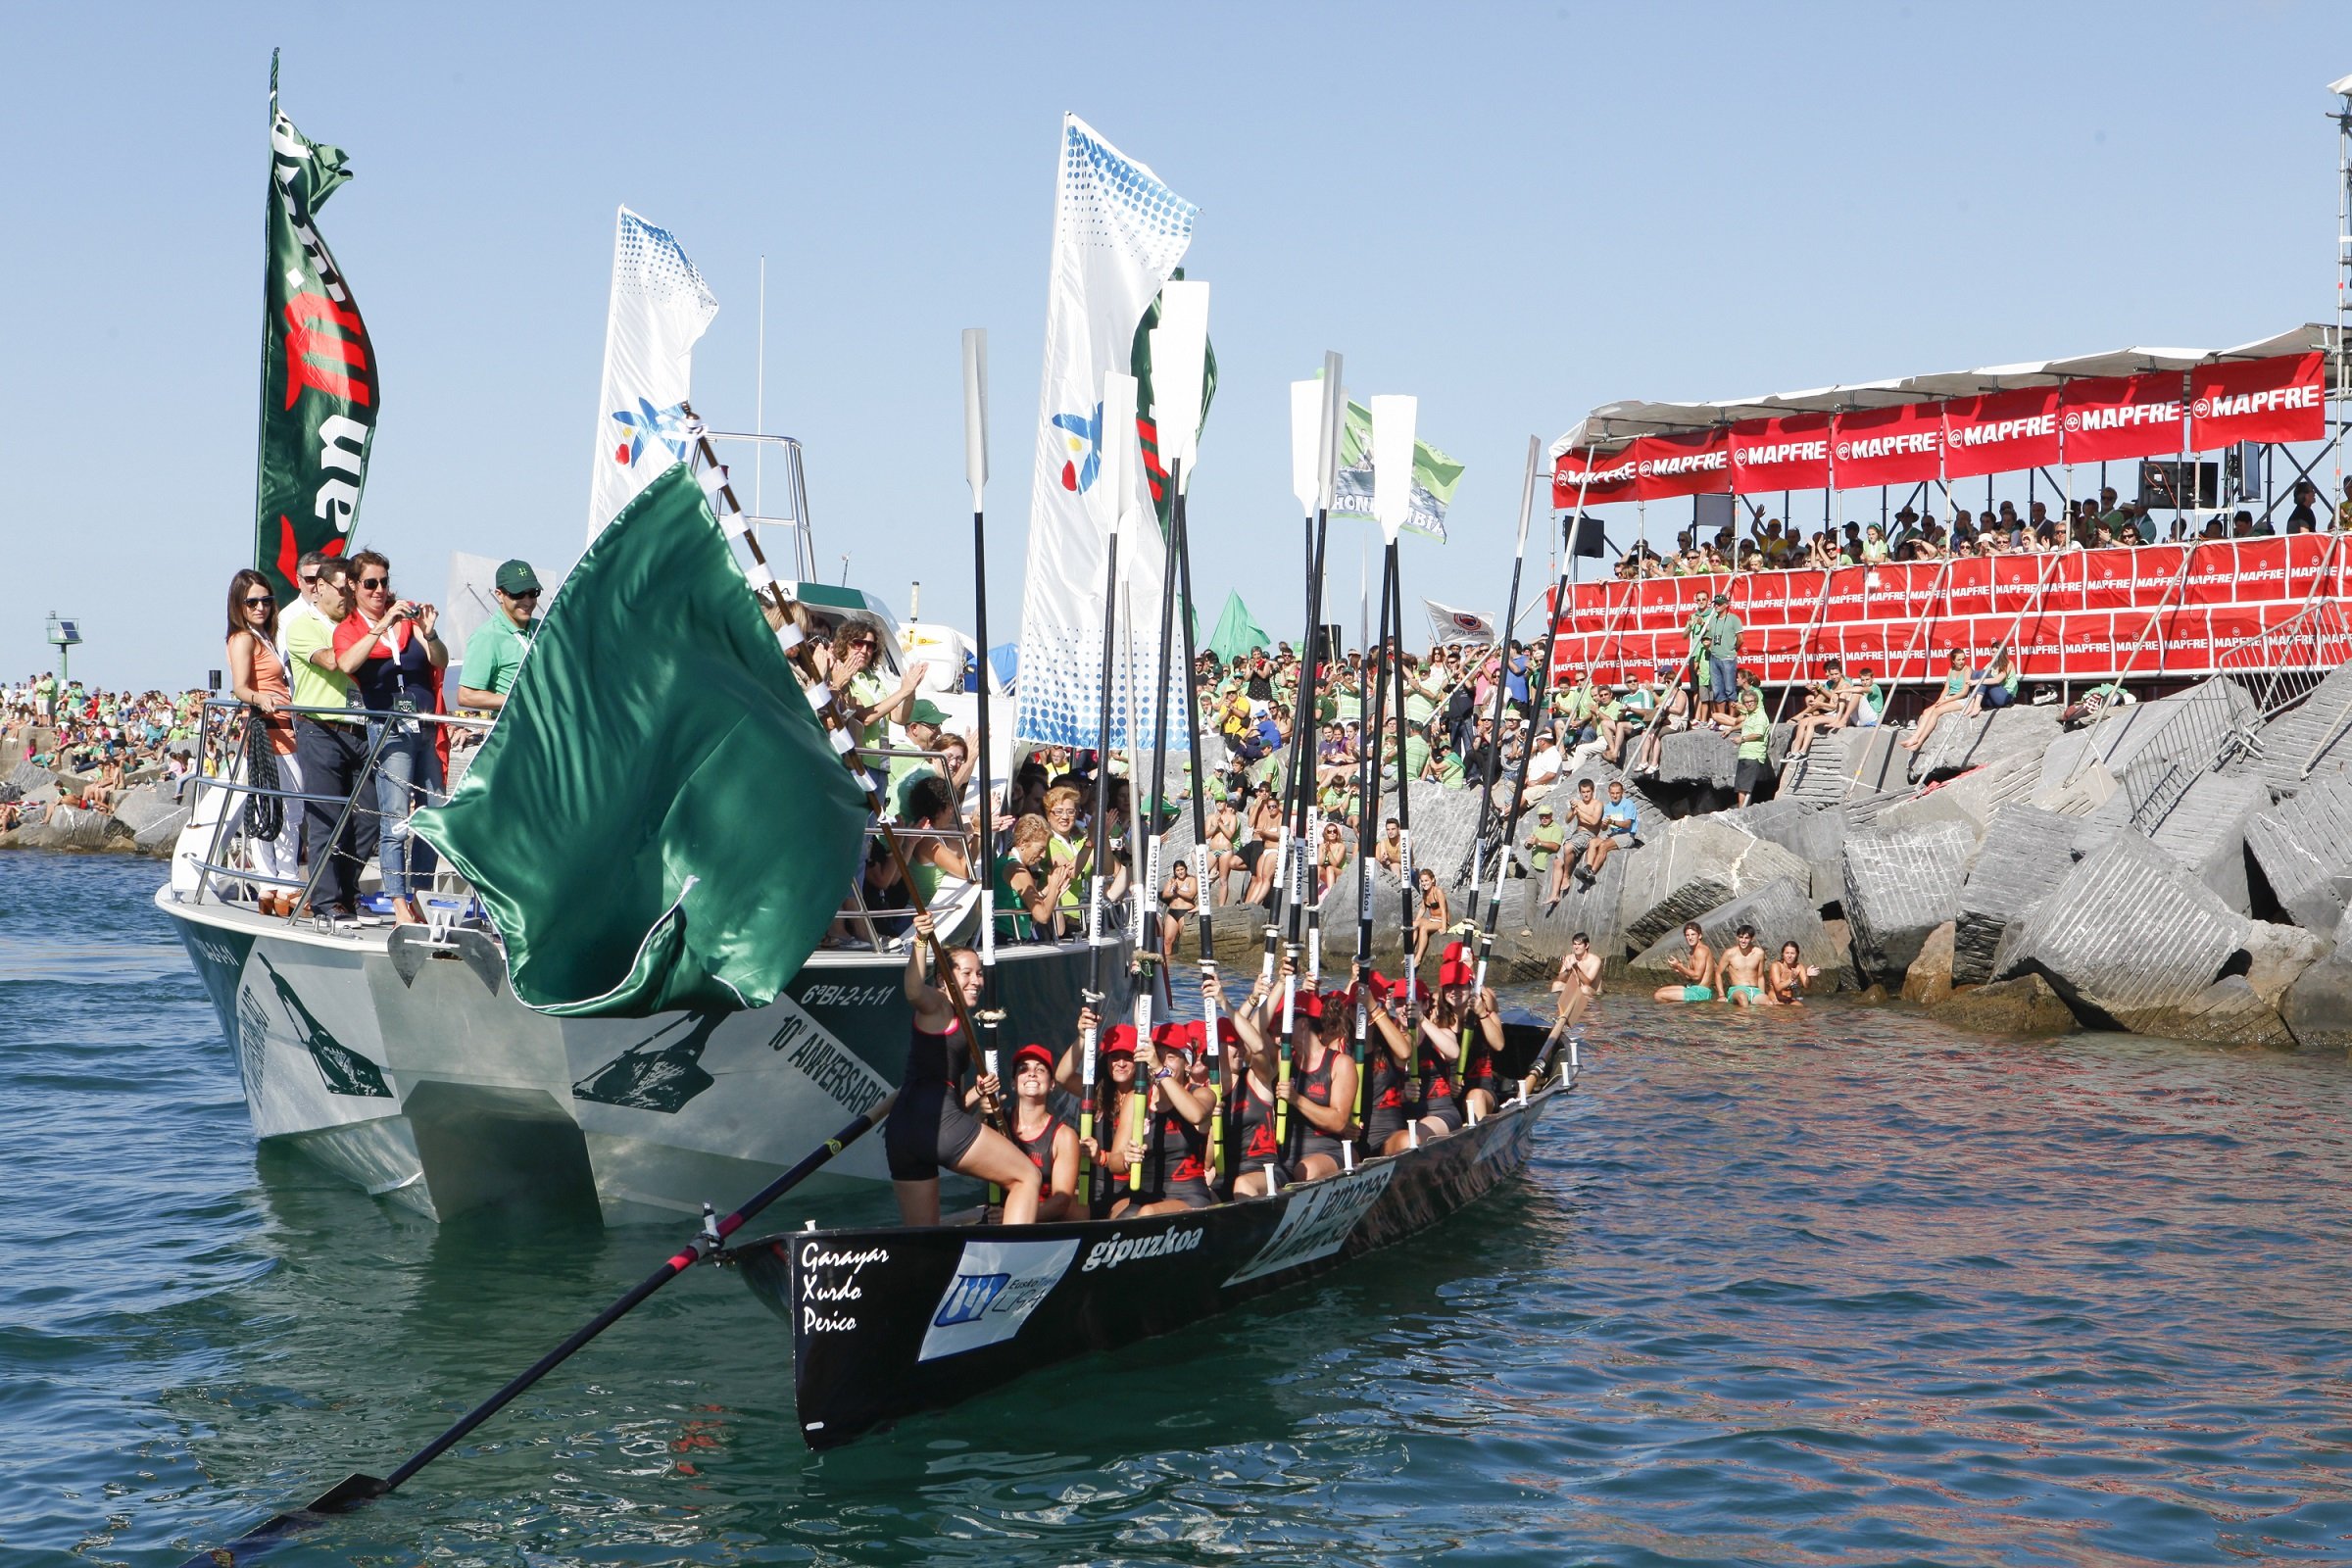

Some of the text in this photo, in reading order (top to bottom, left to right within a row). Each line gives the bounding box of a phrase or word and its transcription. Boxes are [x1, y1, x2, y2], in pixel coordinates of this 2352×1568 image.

[2211, 384, 2320, 417] MAPFRE
[2082, 400, 2180, 431] MAPFRE
[1964, 413, 2056, 447] MAPFRE
[1851, 431, 1937, 460] MAPFRE
[1747, 440, 1828, 466] MAPFRE
[1651, 451, 1727, 475] MAPFRE
[2186, 573, 2233, 585] MAPFRE
[2238, 568, 2284, 582] MAPFRE
[1995, 583, 2036, 594] MAPFRE
[2087, 578, 2132, 589] MAPFRE
[1868, 591, 1906, 602] MAPFRE
[1910, 589, 1946, 600] MAPRE
[1951, 585, 1990, 598] MAPFRE
[1750, 598, 1785, 608] MAPFRE
[1829, 593, 1864, 605] MAPFRE
[1576, 608, 1605, 617] MAPFRE
[1642, 604, 1676, 614] MAPFRE
[2021, 644, 2059, 656] MAPFRE
[2065, 642, 2110, 654] MAPFRE
[2165, 638, 2208, 650] MAPFRE
[1737, 654, 1764, 664] APFRE
[1806, 652, 1841, 662] MAPFRE
[1846, 651, 1885, 662] MAPFRE
[1931, 647, 1970, 659] MAPE
[1554, 661, 1586, 672] MAPFRE
[1623, 658, 1653, 667] MAPFRE
[1657, 657, 1688, 666] MAPFR
[1148, 845, 1158, 903] gipuzkoa
[1199, 854, 1209, 906] gipuzkoa
[801, 985, 896, 1005] 6ªBI-2-1-11
[1081, 1225, 1204, 1272] gipuzkoa
[802, 1242, 890, 1275] Garayar
[802, 1274, 862, 1302] Xurdo
[803, 1305, 858, 1336] Perico
